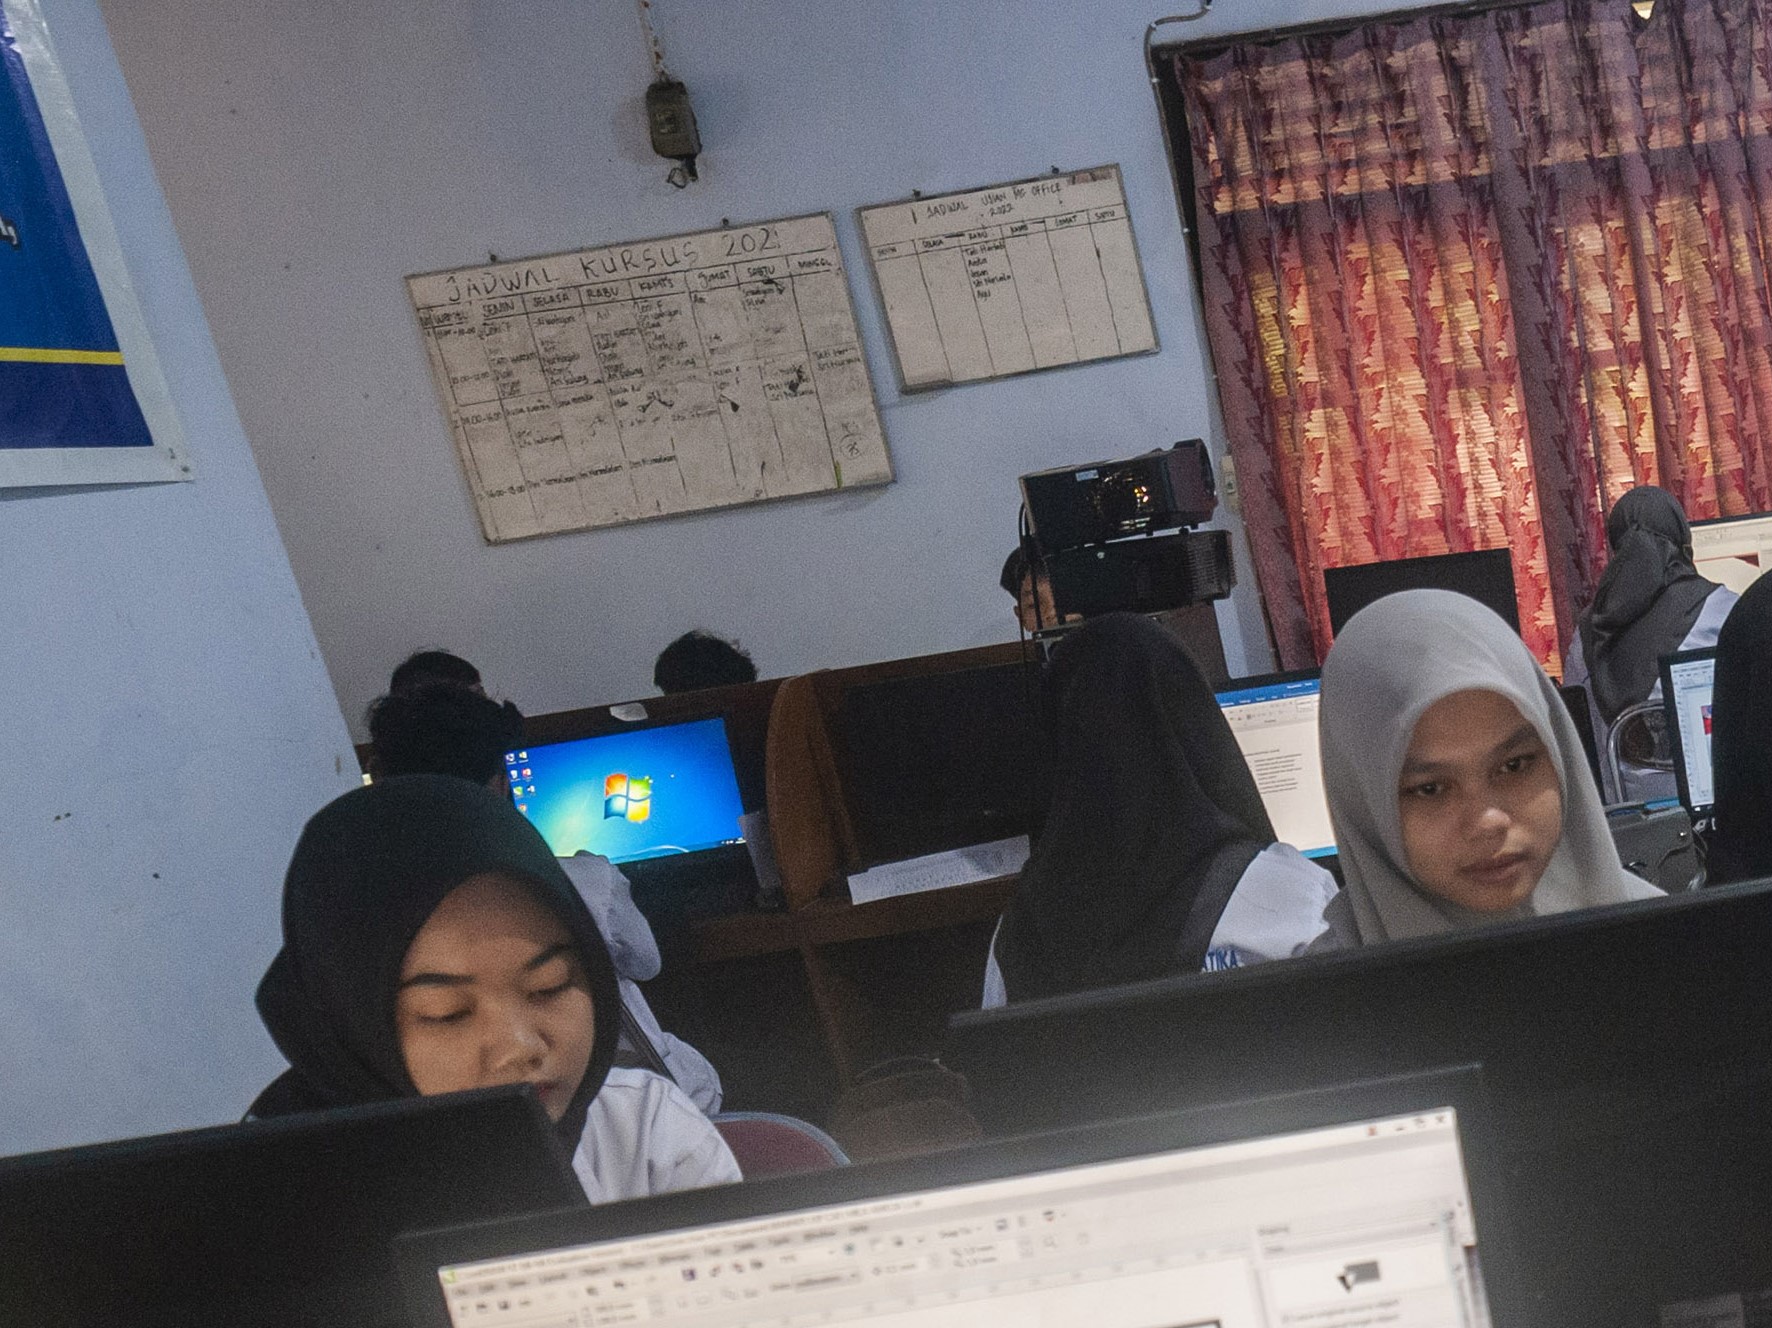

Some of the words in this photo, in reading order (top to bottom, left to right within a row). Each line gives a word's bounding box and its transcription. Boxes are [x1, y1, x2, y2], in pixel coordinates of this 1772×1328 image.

[1031, 182, 1062, 197] OFFICE
[446, 267, 560, 302] JADWAL
[579, 240, 699, 279] KURSUS
[586, 286, 620, 300] RABU
